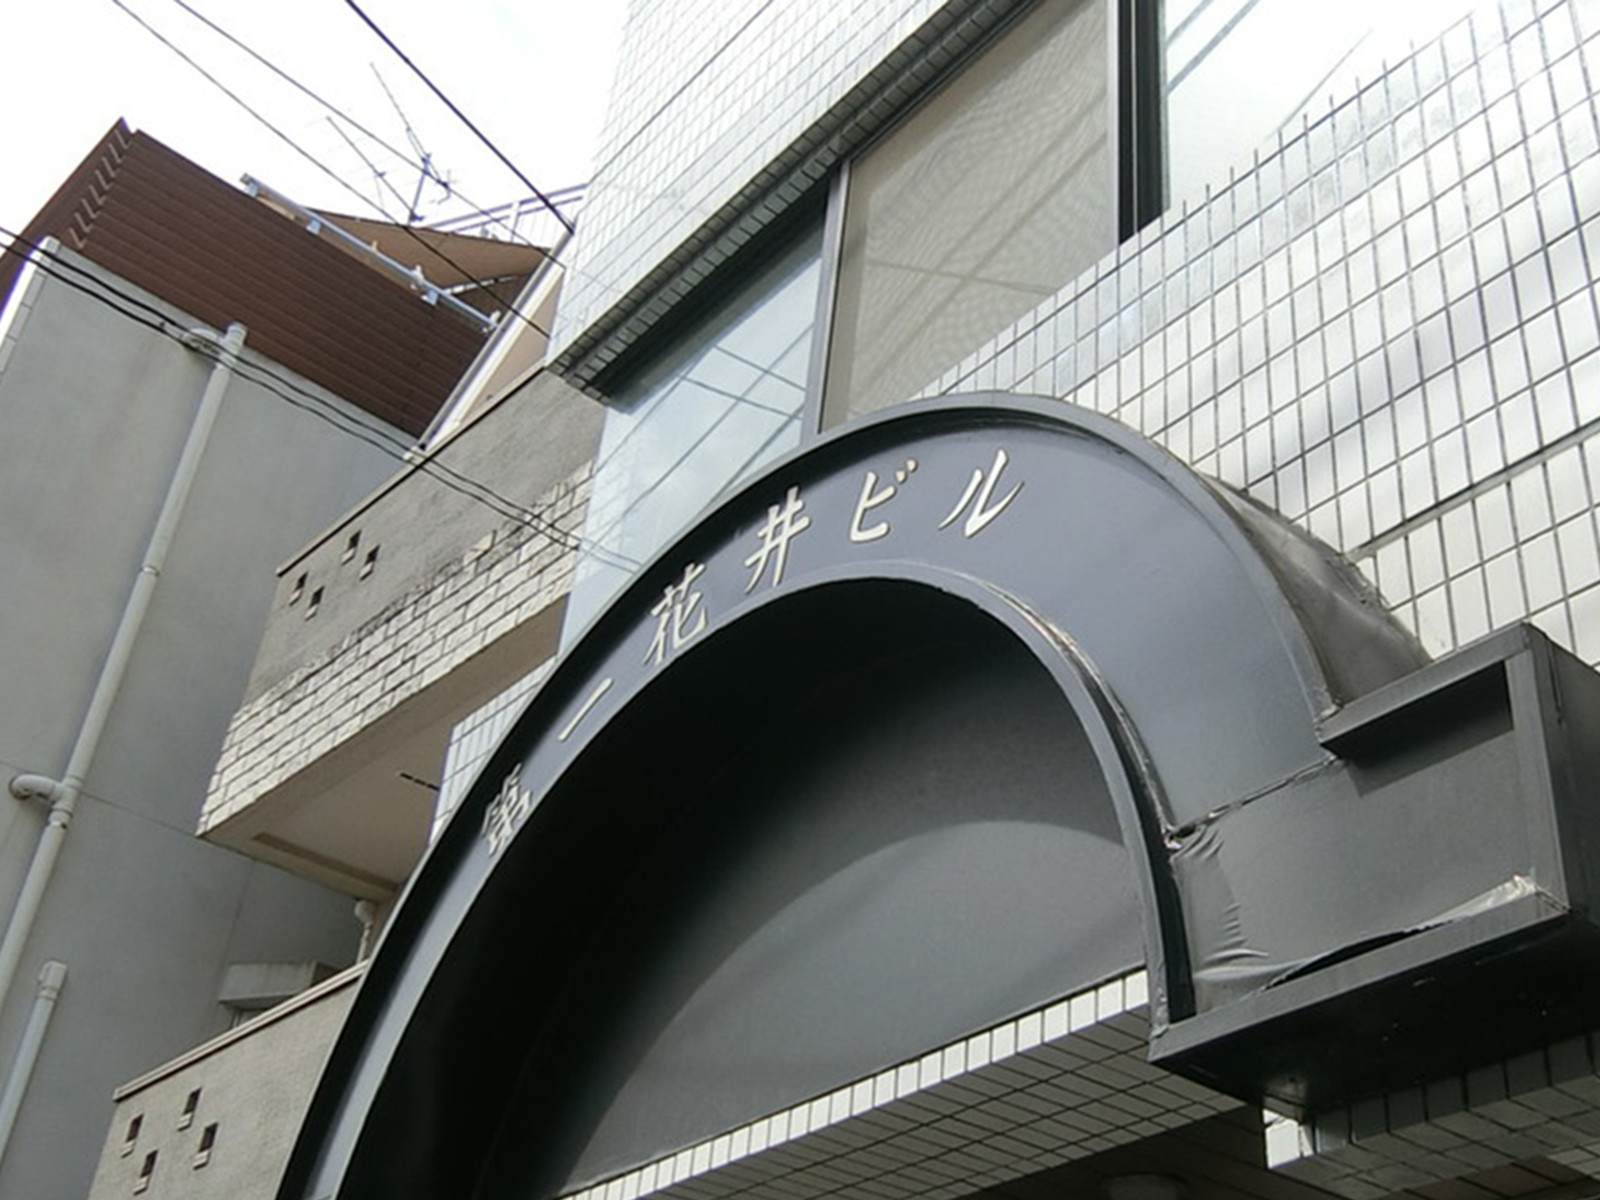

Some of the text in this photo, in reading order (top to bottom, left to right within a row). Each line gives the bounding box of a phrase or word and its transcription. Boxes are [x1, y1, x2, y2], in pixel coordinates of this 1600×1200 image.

[482, 449, 1024, 856] 第一花井ビル
